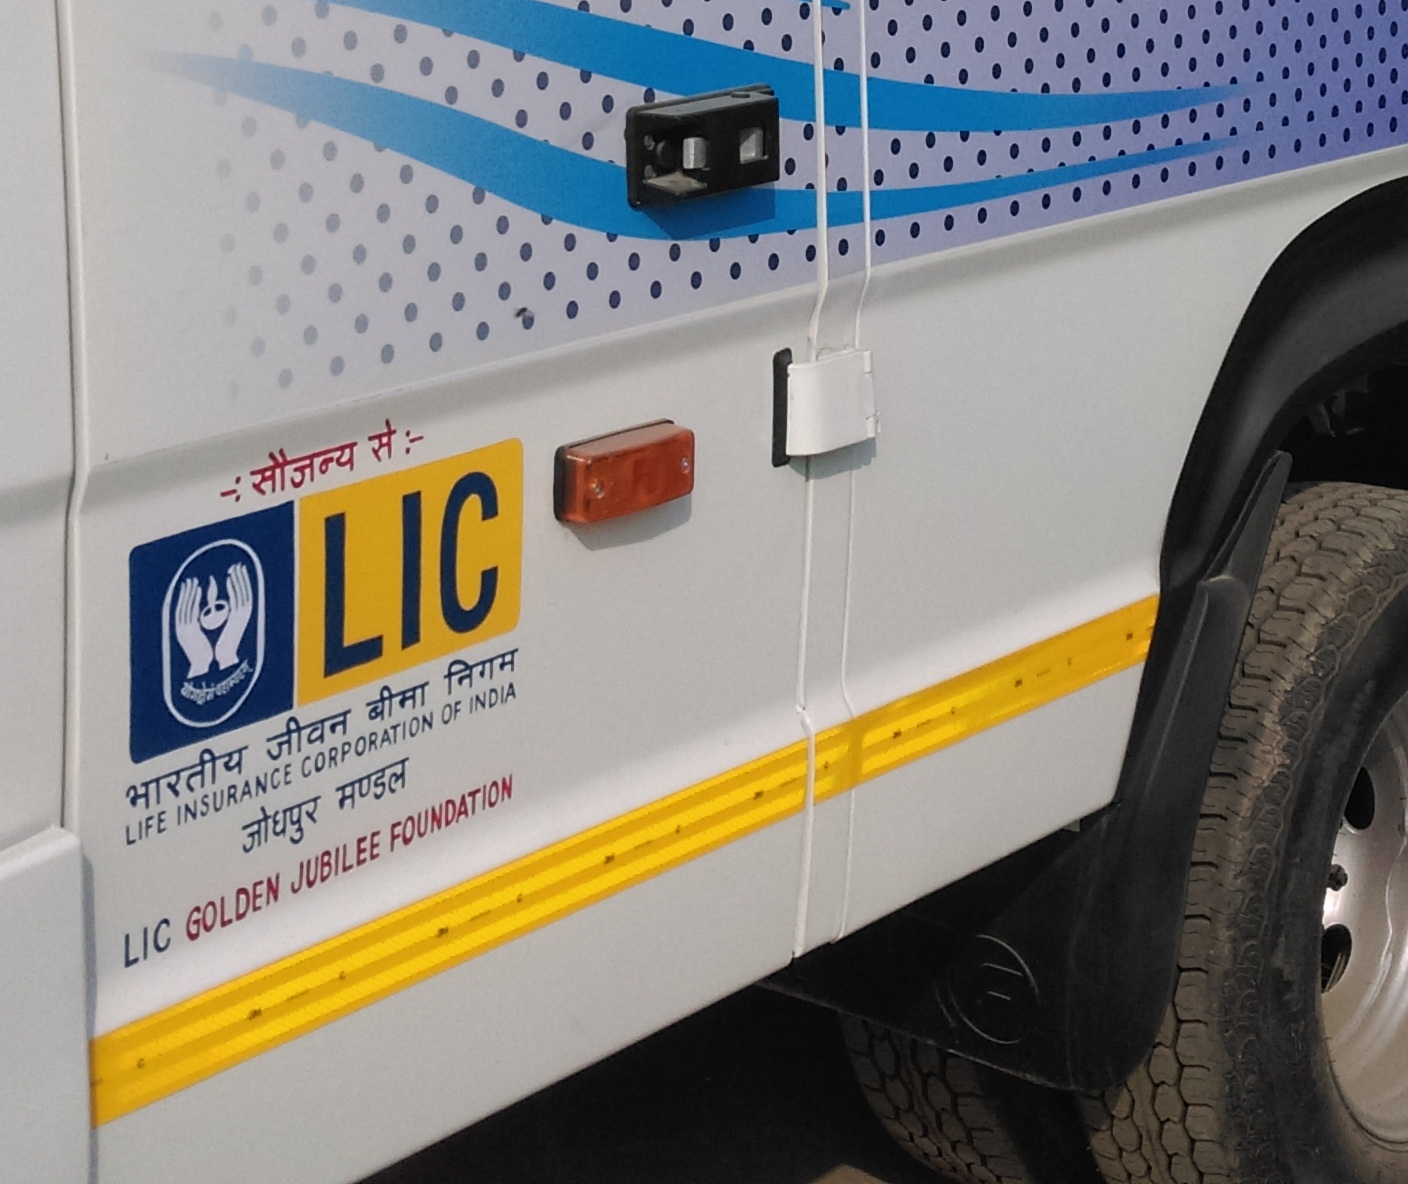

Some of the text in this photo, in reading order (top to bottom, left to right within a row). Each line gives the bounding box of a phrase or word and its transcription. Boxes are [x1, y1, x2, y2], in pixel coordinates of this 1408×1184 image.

[368, 418, 396, 462] से
[322, 471, 500, 679] LIC
[125, 648, 520, 811] भारतीय जीवन बीमा निगम
[125, 682, 518, 846] LIFE INSURANCE CORPORATION OF INDIA
[240, 757, 410, 855] जोधपुर मण्डल
[123, 774, 514, 968] LIC GOLDEN JUBILEE FOUNDATION
